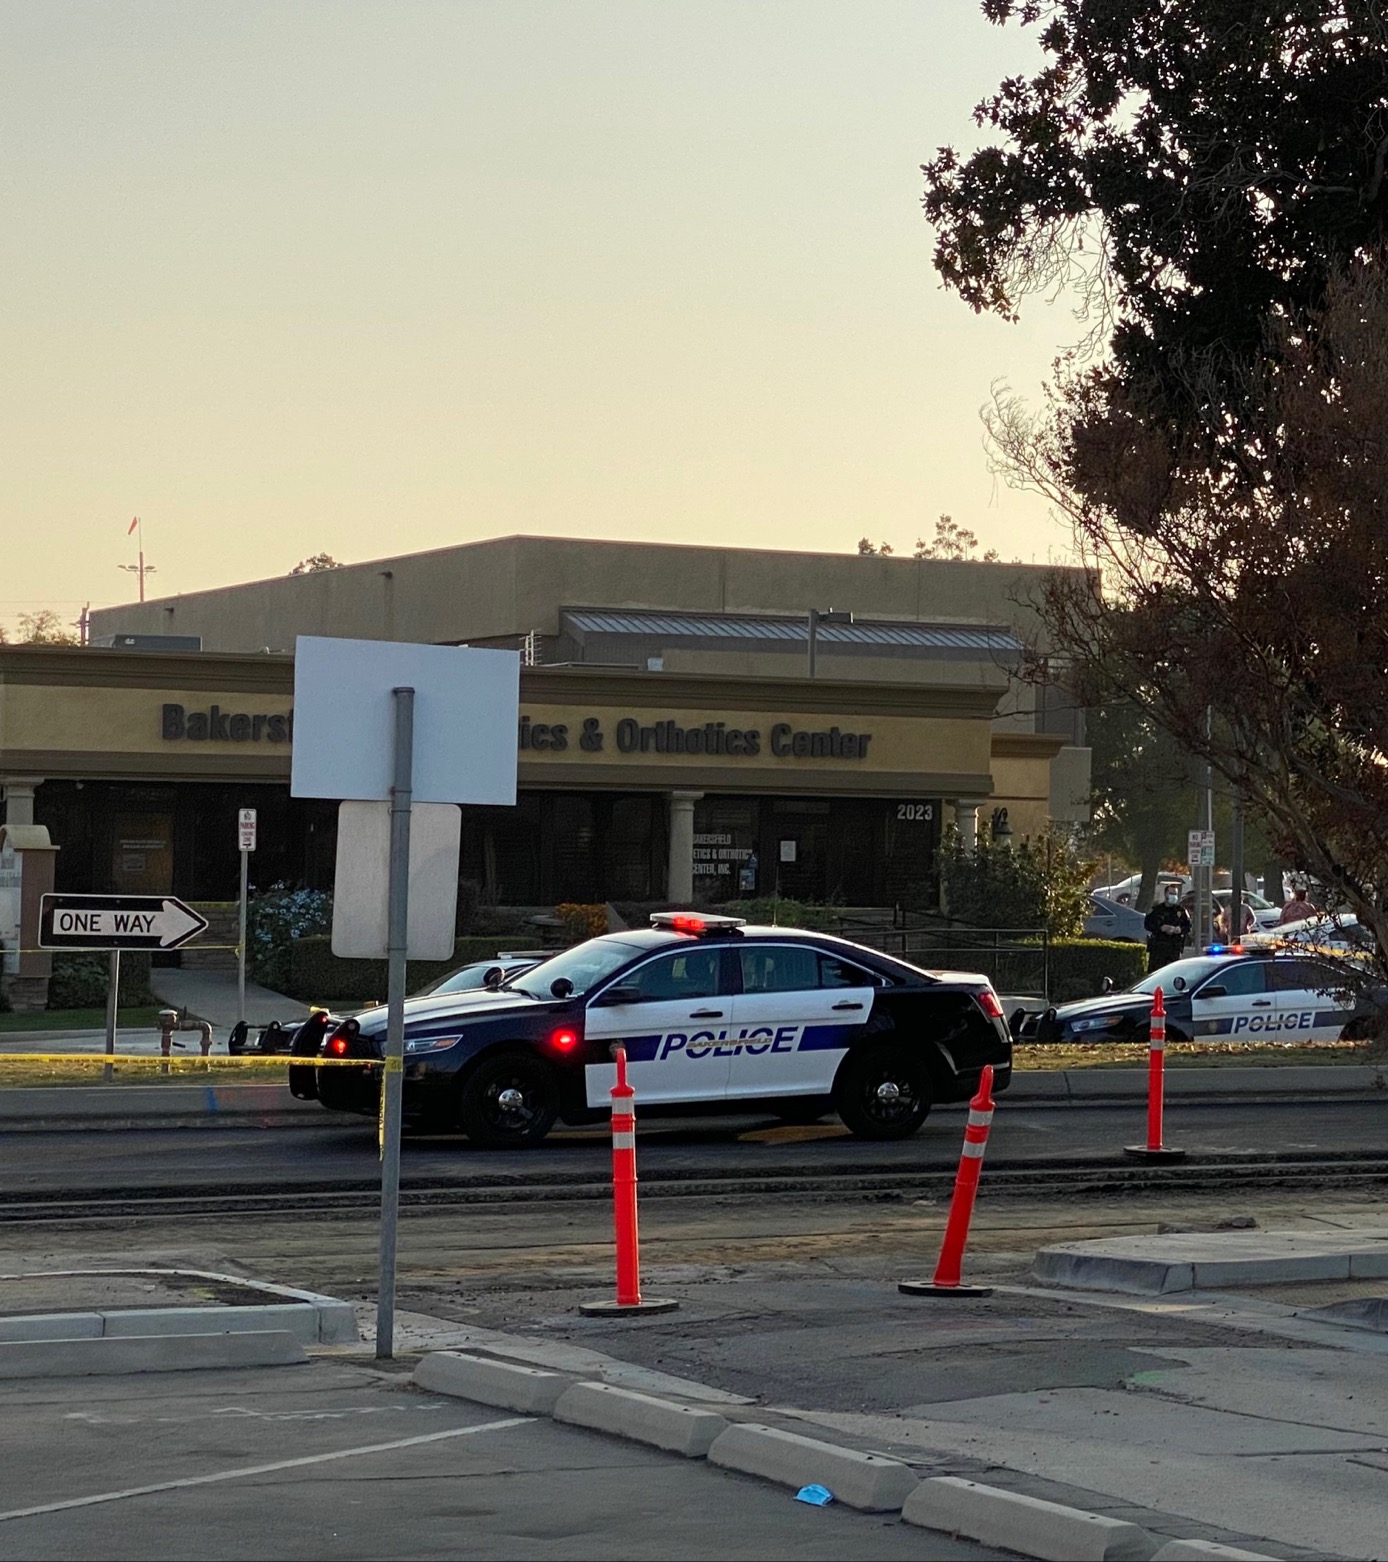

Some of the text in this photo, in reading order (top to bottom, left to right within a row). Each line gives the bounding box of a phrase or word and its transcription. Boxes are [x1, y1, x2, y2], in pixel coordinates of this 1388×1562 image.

[519, 715, 568, 751] ics
[579, 717, 604, 752] &
[616, 717, 760, 756] Orthotics
[771, 722, 873, 759] Center
[897, 804, 933, 820] 2023
[694, 848, 711, 860] ETICS
[711, 848, 718, 860] &
[717, 863, 731, 875] INC.
[59, 913, 156, 933] ONE WAY
[1234, 1012, 1312, 1033] POLICE
[659, 1026, 799, 1060] POLICE
[686, 1037, 773, 1048] BAKERSFIELD
